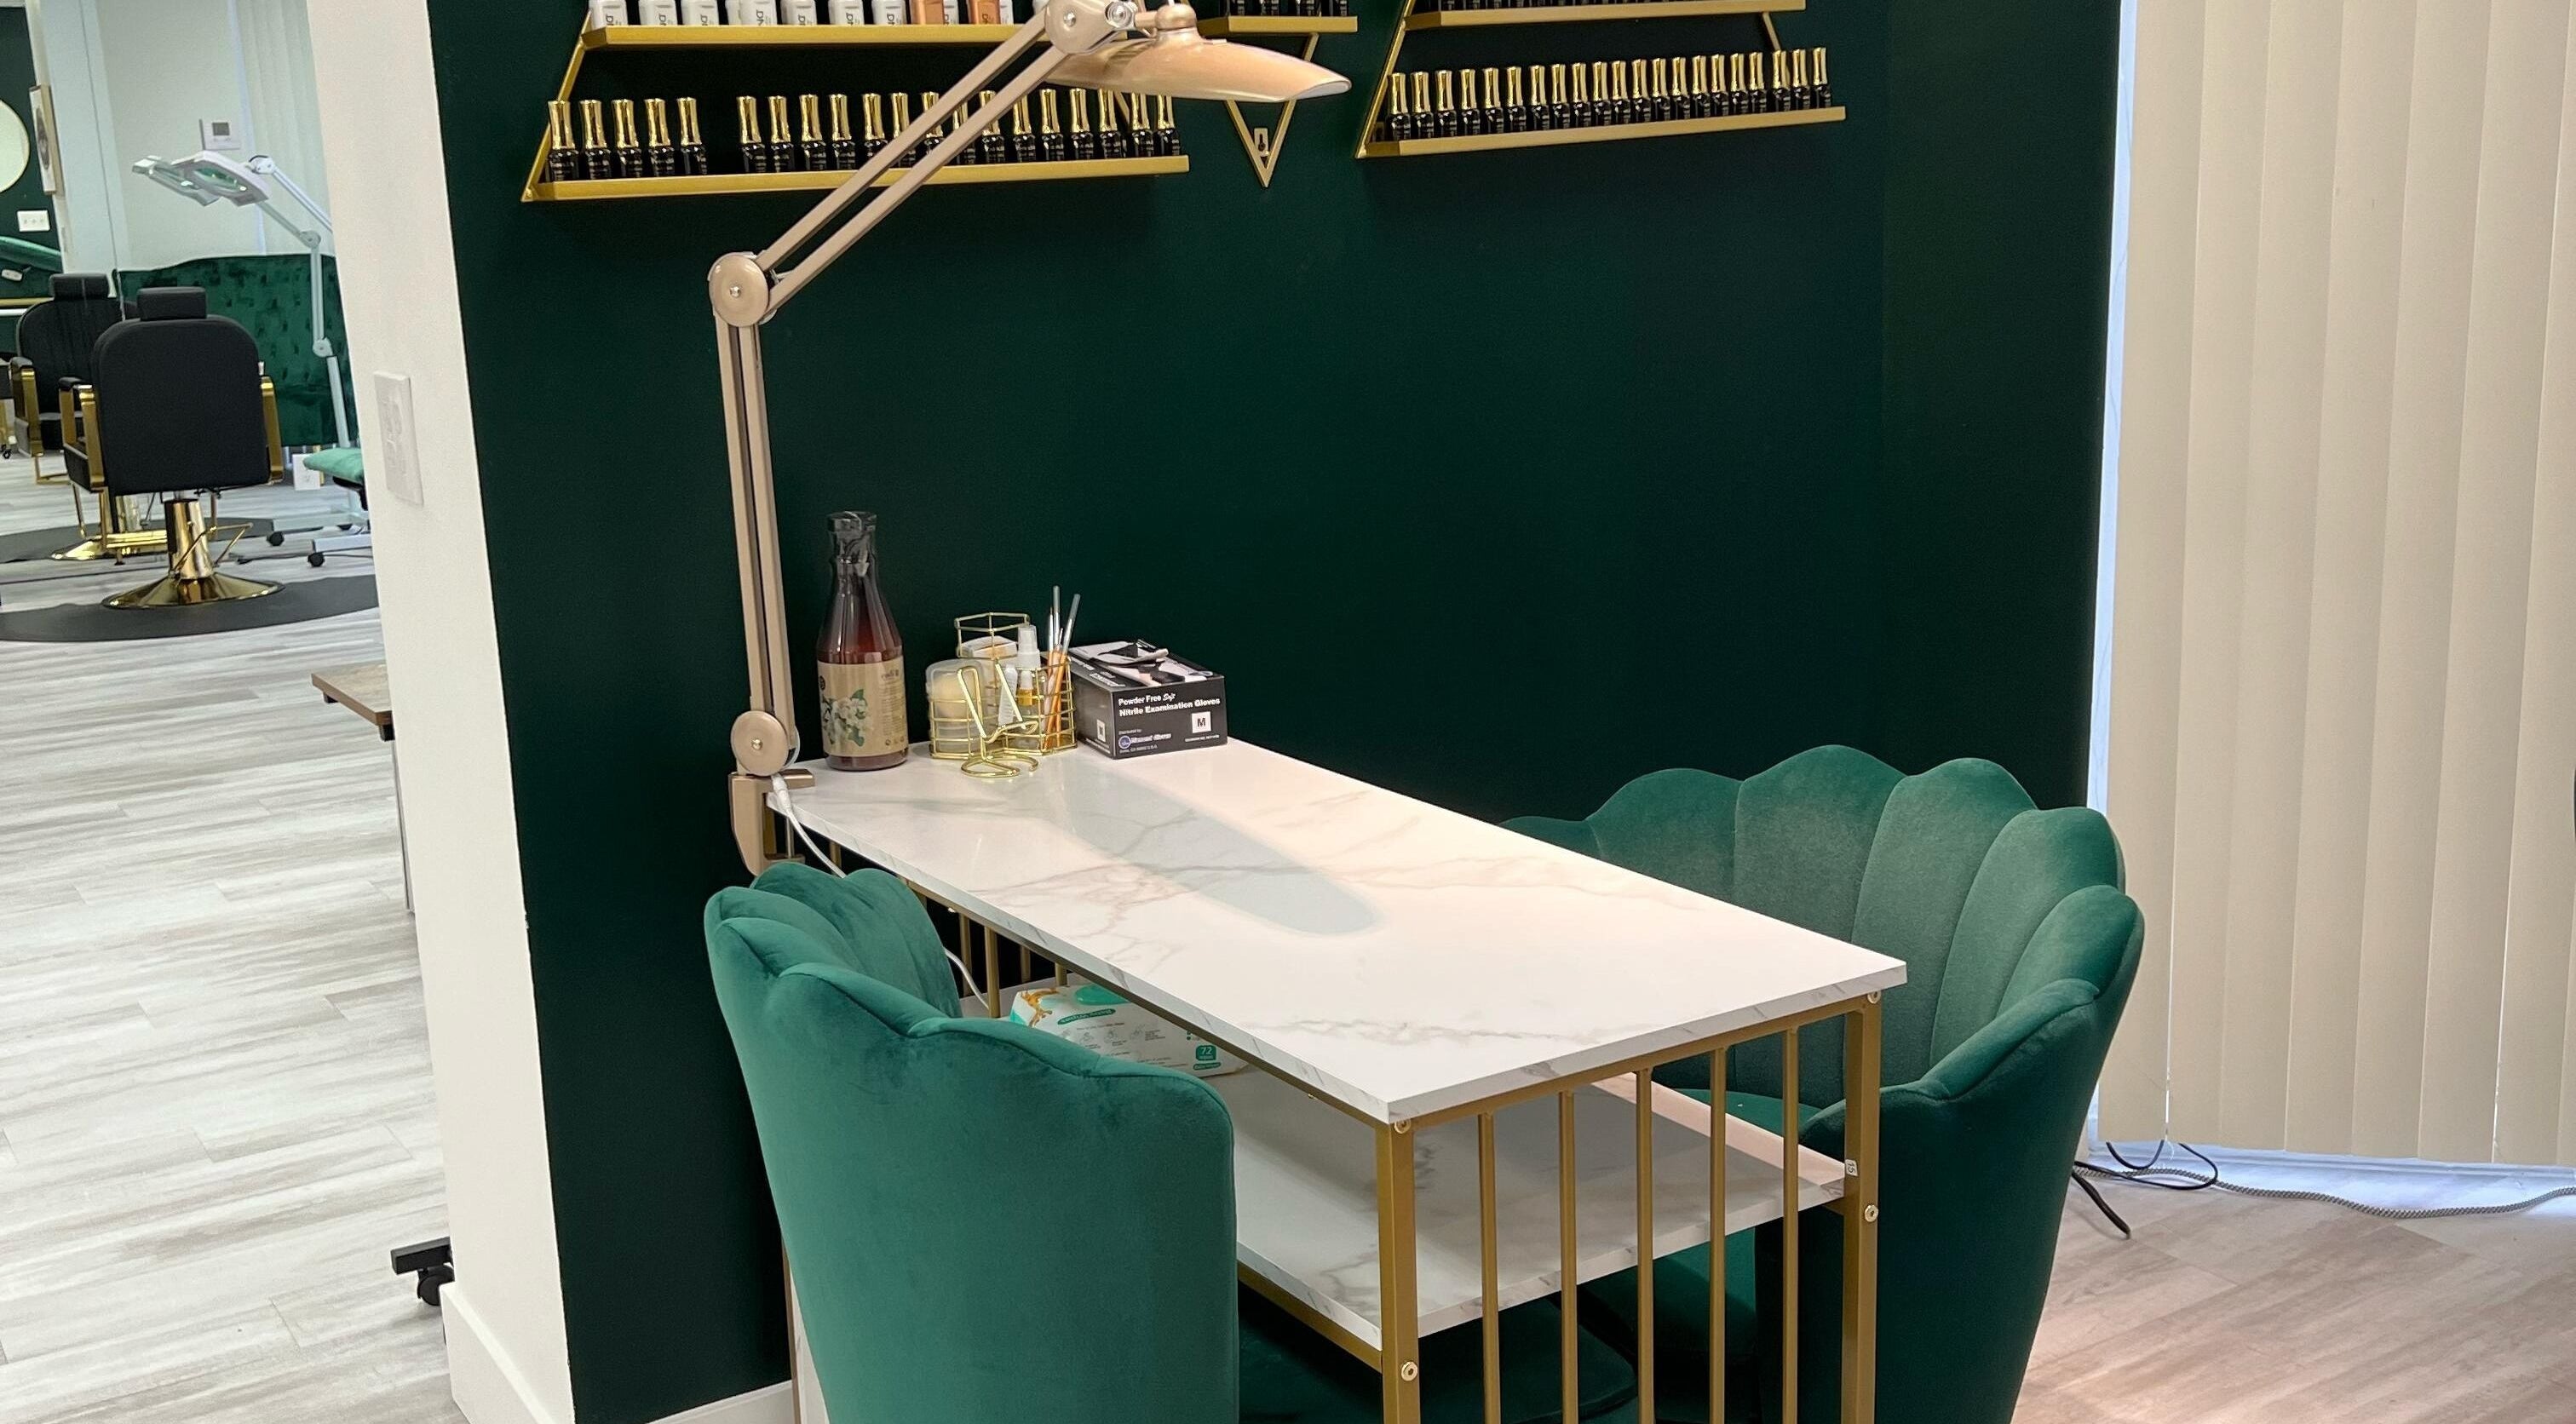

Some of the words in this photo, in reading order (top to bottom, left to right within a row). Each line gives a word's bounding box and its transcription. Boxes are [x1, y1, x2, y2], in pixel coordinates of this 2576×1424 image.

[1118, 697, 1145, 706] Powder
[1146, 694, 1161, 703] Free
[1119, 707, 1144, 716] Nitrile
[1145, 701, 1193, 713] Examination
[1194, 698, 1221, 707] Gloves
[1197, 717, 1206, 727] M
